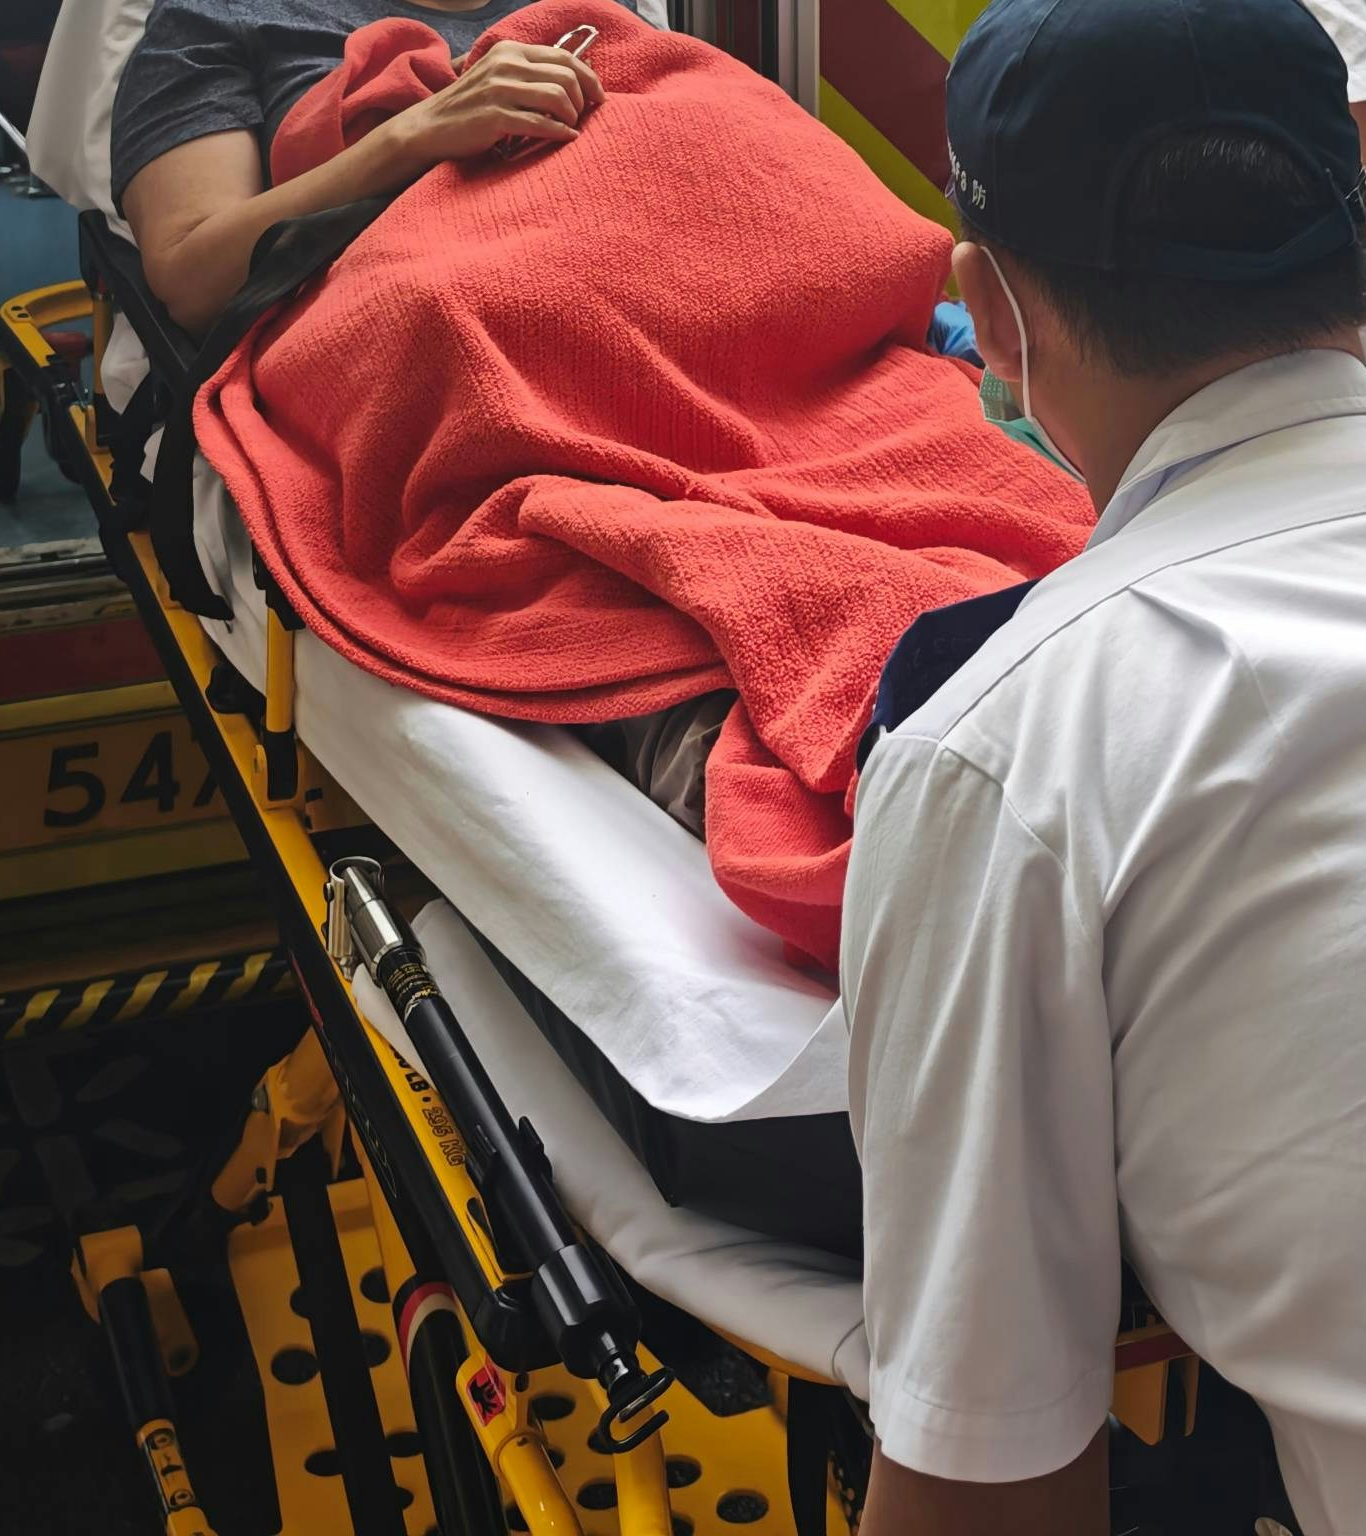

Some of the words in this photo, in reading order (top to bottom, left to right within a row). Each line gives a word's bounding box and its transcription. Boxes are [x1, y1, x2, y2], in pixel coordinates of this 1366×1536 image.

[405, 1071, 431, 1092] LB
[422, 1106, 454, 1138] 295
[439, 1139, 466, 1167] KG
